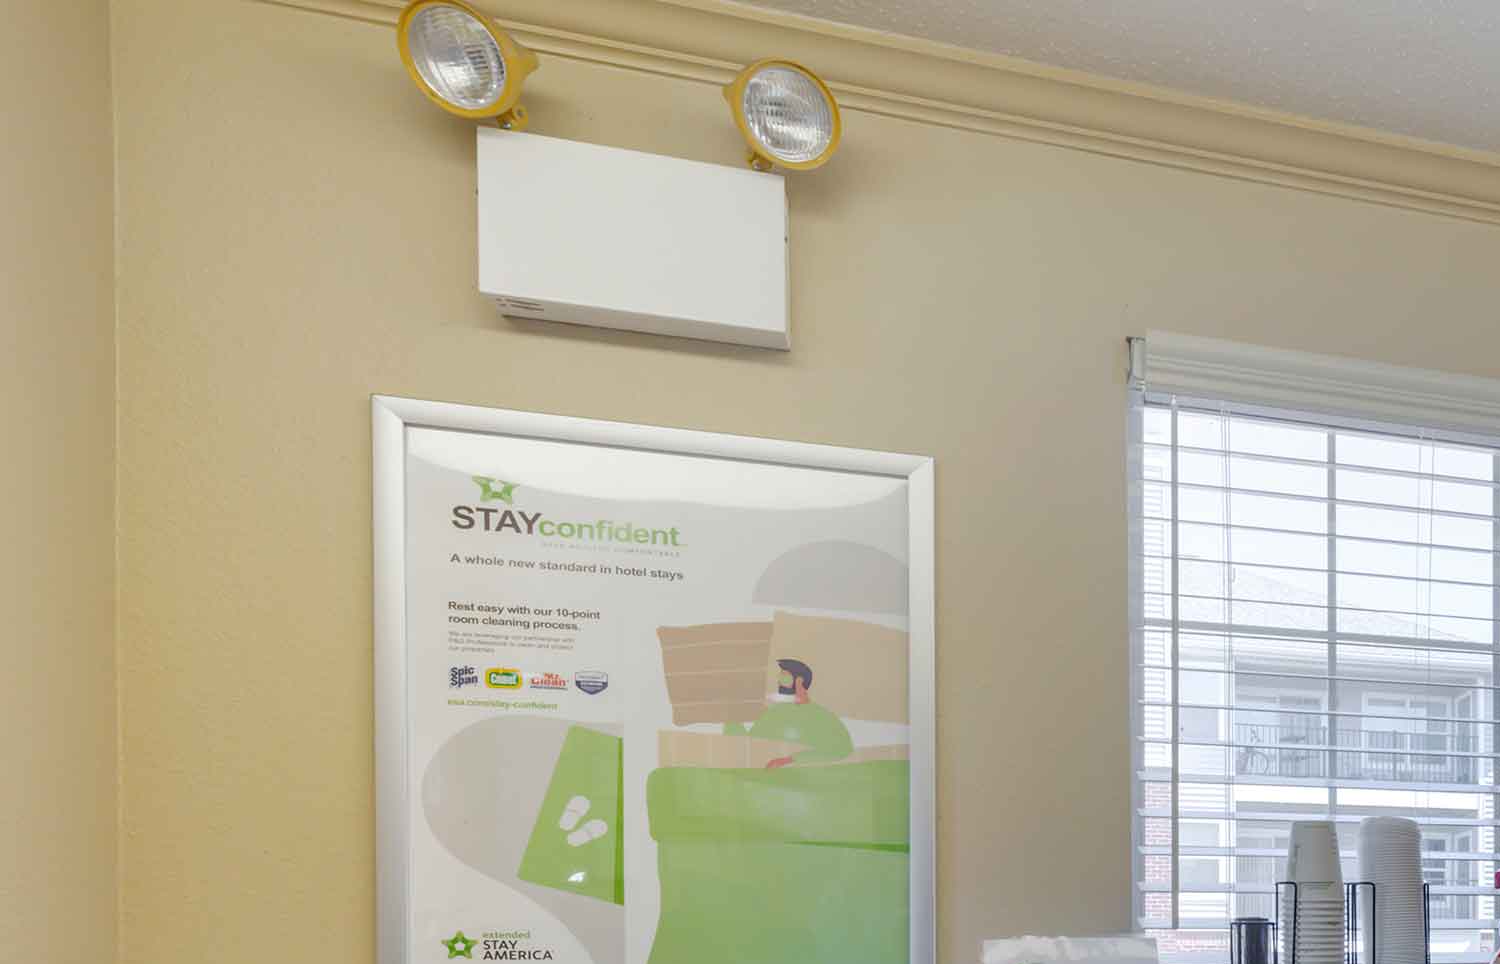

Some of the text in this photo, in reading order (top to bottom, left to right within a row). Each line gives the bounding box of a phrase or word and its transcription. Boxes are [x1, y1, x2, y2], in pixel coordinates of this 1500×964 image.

[450, 553, 684, 581] A whole new standard in hotel stays
[448, 601, 600, 620] Rest easy with our 10-point
[448, 616, 479, 625] room
[482, 617, 530, 630] cleaning
[482, 940, 518, 950] STAY
[482, 951, 553, 960] AMERICA
